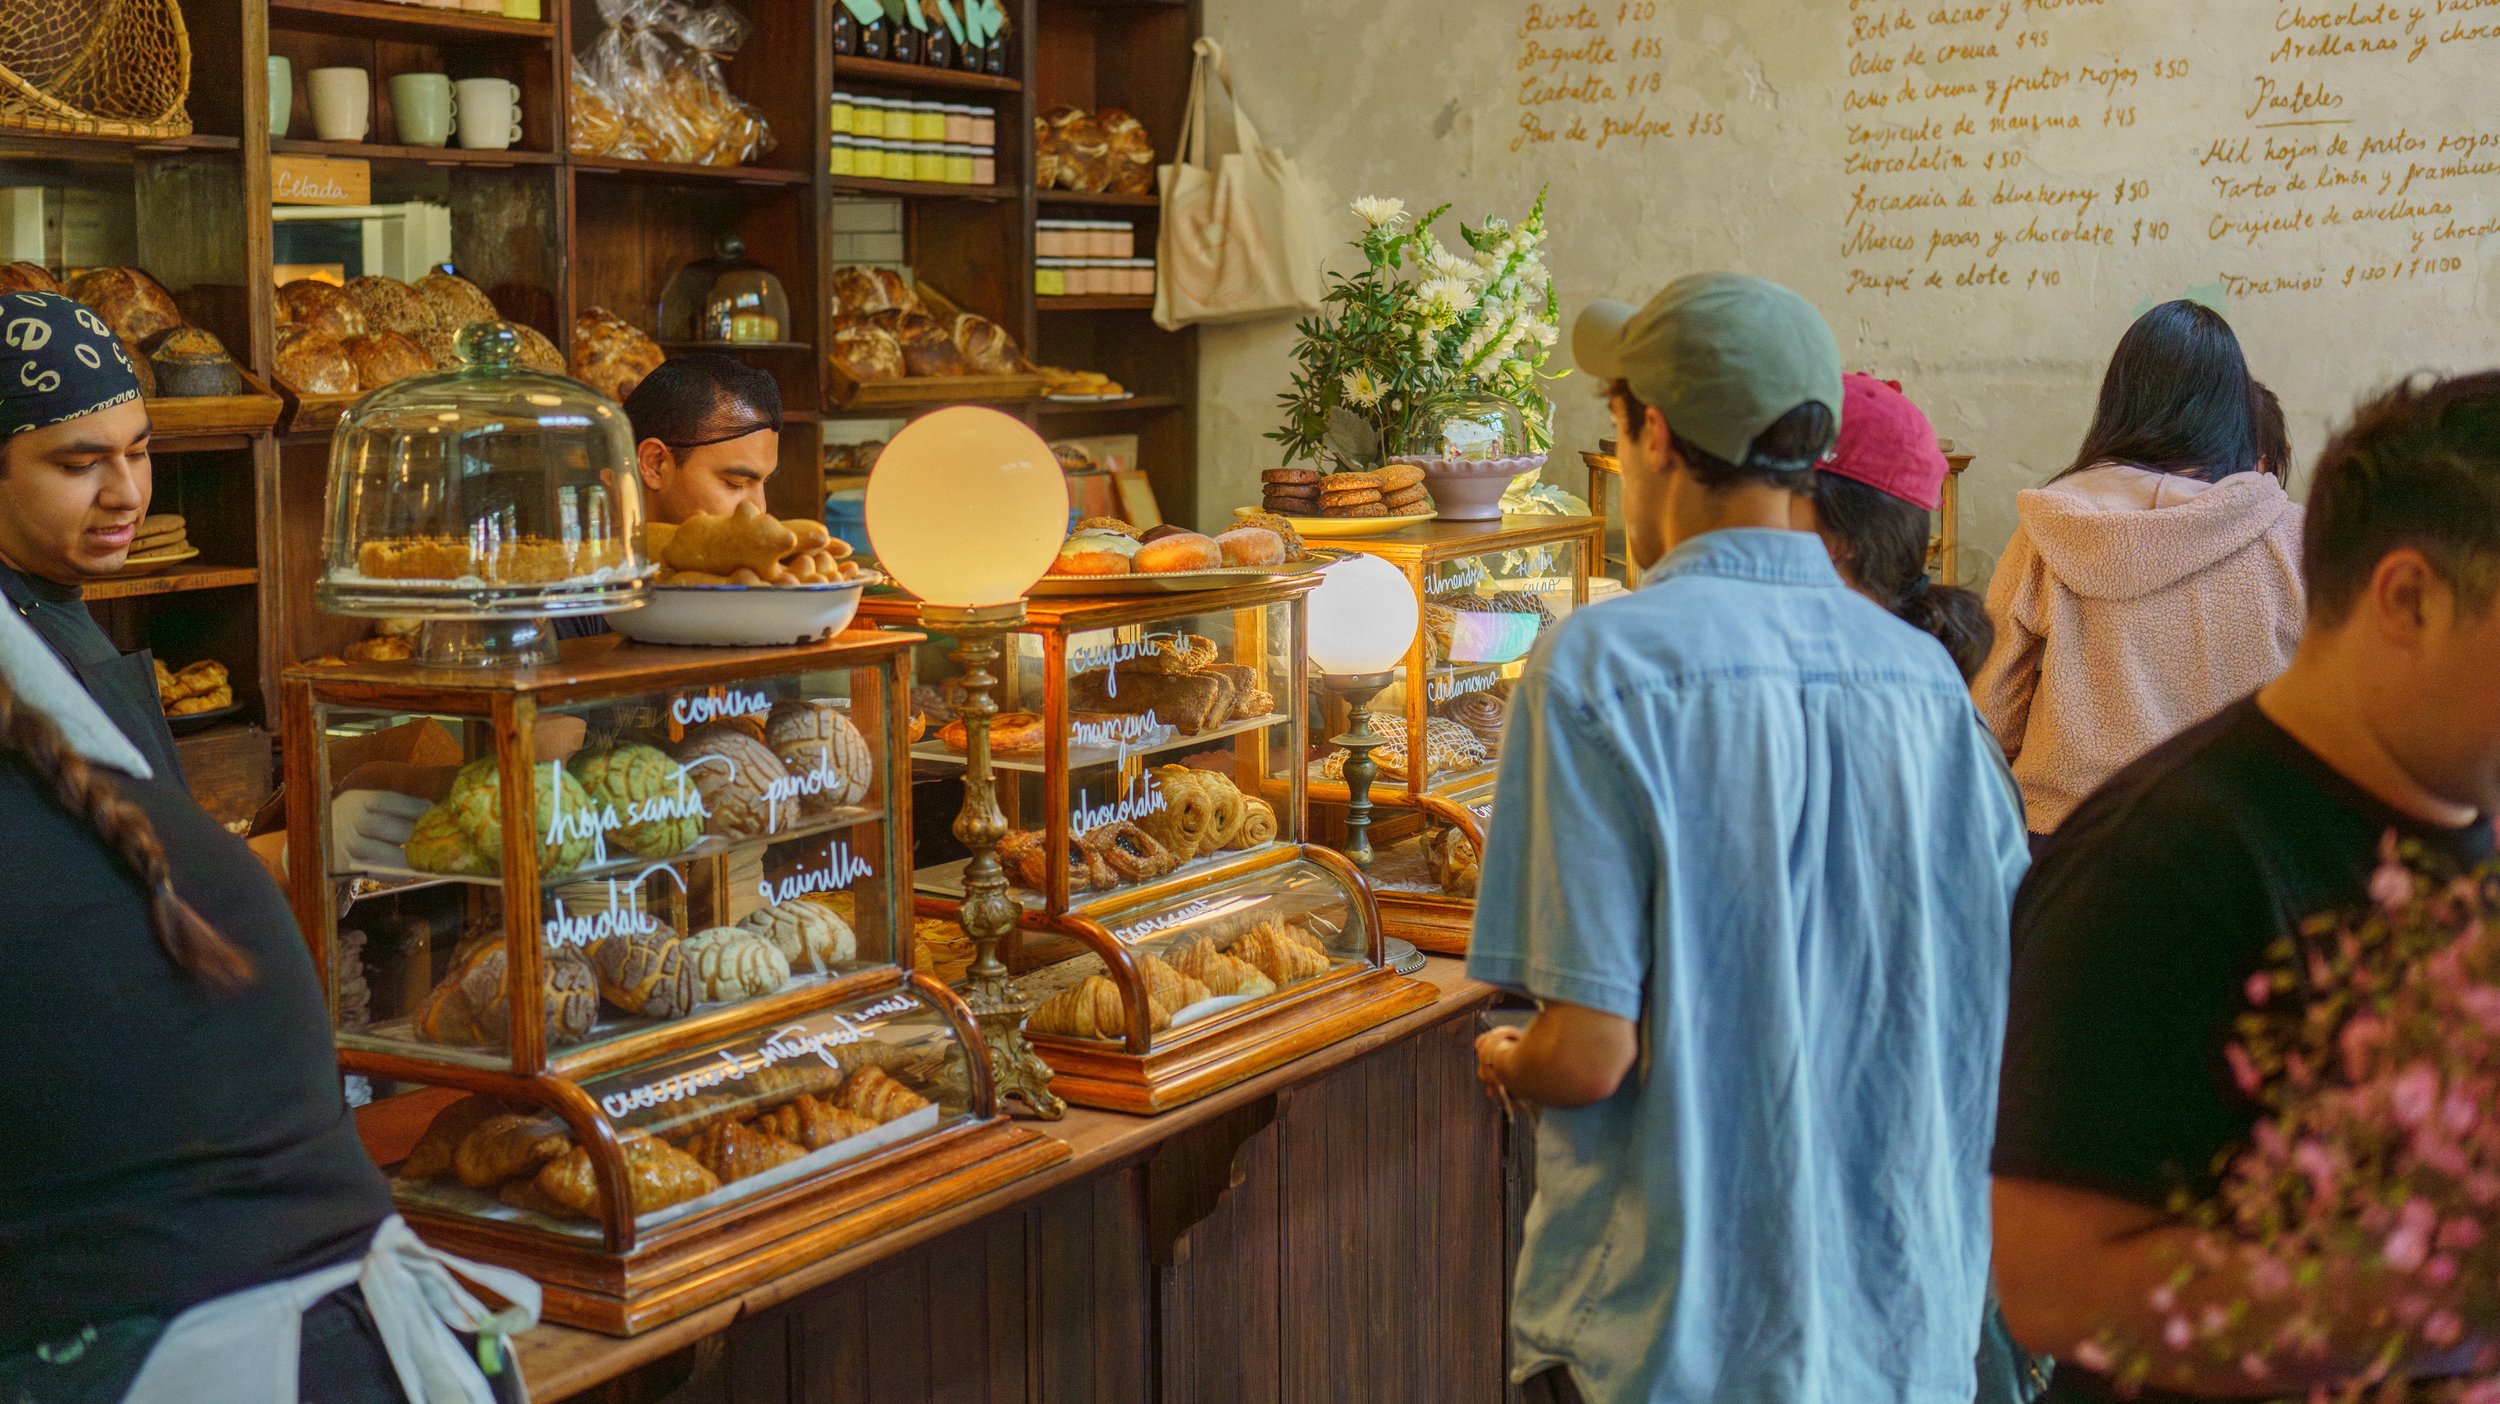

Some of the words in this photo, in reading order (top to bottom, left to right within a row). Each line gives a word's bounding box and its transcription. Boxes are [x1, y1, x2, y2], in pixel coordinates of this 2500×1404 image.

[1894, 8, 1916, 31] de
[1928, 8, 1992, 27] cacao
[1996, 0, 2012, 32] y
[2276, 2, 2400, 32] Chocolate
[2404, 7, 2426, 36] y
[1517, 36, 1617, 74] Baguette
[1851, 51, 1893, 78] Ocho
[1904, 44, 1925, 67] de
[1937, 43, 1998, 65] crema
[2271, 35, 2398, 63] Avellanas
[2407, 34, 2428, 64] y
[1896, 76, 1918, 104] de
[1925, 79, 1978, 99] crema
[1986, 79, 2000, 105] y
[2079, 58, 2138, 98] rojos
[2246, 76, 2344, 120] Pasteles
[1565, 116, 1588, 142] de
[1953, 112, 1975, 136] de
[2327, 132, 2349, 157] de
[278, 170, 349, 200] Cebada
[1956, 187, 1978, 208] de
[2211, 175, 2278, 200] Tarta
[2287, 173, 2308, 193] de
[2377, 171, 2393, 196] y
[2322, 204, 2343, 226] de
[2352, 198, 2454, 222] avellanas
[1926, 228, 1981, 263] pasas
[1986, 230, 2008, 258] y
[2014, 216, 2115, 245] chocolate
[2411, 228, 2426, 253] y
[1924, 268, 1944, 289] de
[1956, 263, 2011, 286] elote
[1174, 630, 1194, 655] de
[672, 690, 773, 725] concha
[760, 746, 841, 835] pinole
[545, 758, 622, 866] hoja
[626, 754, 735, 827] santa
[758, 841, 873, 907] vainilla
[546, 863, 687, 949] chocolate
